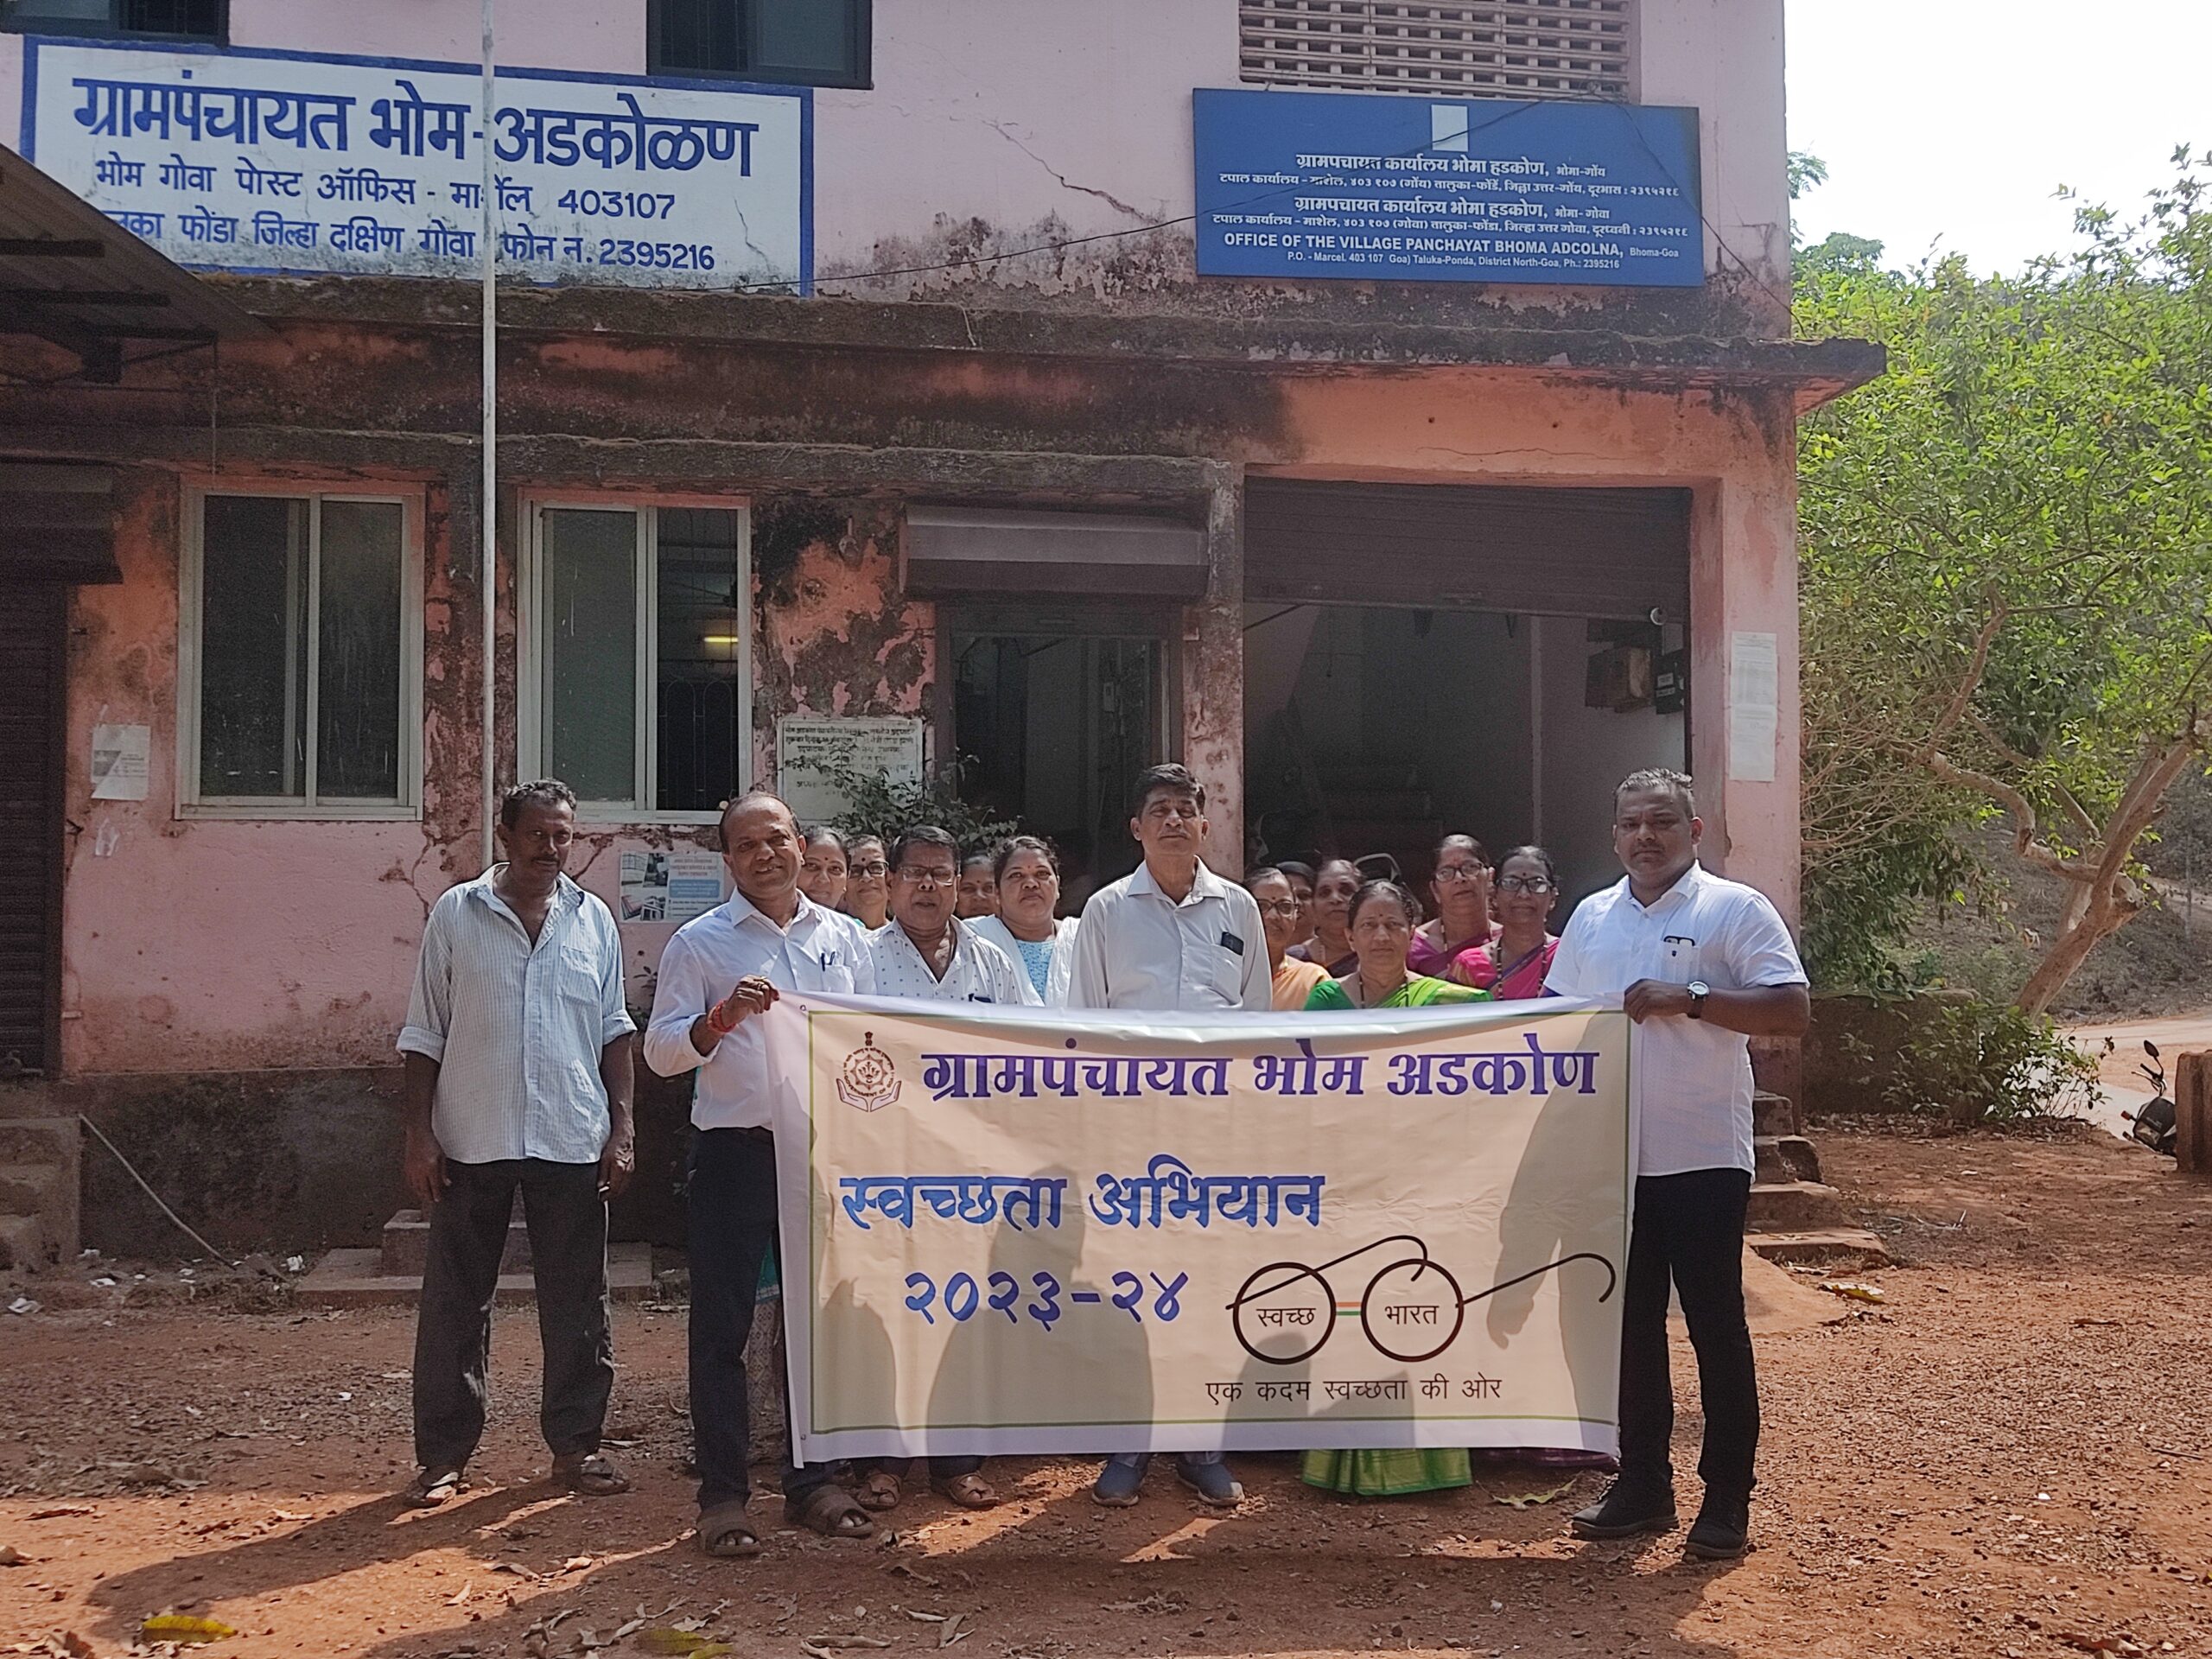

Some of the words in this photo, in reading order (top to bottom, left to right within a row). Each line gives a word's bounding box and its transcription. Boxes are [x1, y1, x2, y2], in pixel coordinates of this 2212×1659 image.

[73, 70, 356, 151] ग्रामपंचायत
[1219, 173, 1250, 183] टपाल
[1252, 172, 1300, 185] कार्यालय
[1351, 177, 1372, 187] ४०३
[1375, 178, 1397, 188] १०७
[1384, 153, 1449, 172] कार्यालय
[1452, 155, 1487, 174] भोमा
[1490, 156, 1549, 177] हडकोण,
[95, 151, 145, 188] भोम
[159, 153, 217, 192] गोवा
[235, 156, 303, 197] पोस्ट
[317, 167, 416, 204] ऑफिस
[558, 189, 676, 219] 403107
[1382, 195, 1447, 214] कार्यालय
[1451, 197, 1485, 215] भोमा
[1488, 199, 1548, 219] हडकोण,
[178, 205, 238, 244] फोंडा
[252, 210, 320, 249] जिल्हा
[330, 216, 404, 253] दक्षिण
[417, 219, 476, 257] गोवा
[499, 223, 557, 261] फोन
[1212, 214, 1243, 224] टपाल
[1245, 213, 1293, 226] कार्यालय
[1344, 219, 1365, 227] ४०३
[1368, 219, 1389, 228] १०७
[1537, 223, 1559, 233] उत्तर
[1224, 232, 1278, 247] OFFICE
[1281, 234, 1302, 248] OF
[1305, 235, 1336, 249] THE
[1339, 236, 1402, 251] VILLAGE
[1406, 238, 1491, 253] PANCHAYAT
[1495, 239, 1548, 254] BHOMA
[1551, 241, 1624, 258] ADCOLNA,
[1630, 247, 1679, 257] Bhoma-Goa
[1287, 251, 1306, 261] P.O.
[1349, 253, 1365, 263] 403
[1368, 253, 1383, 263] 107
[1389, 254, 1411, 265] Goa)
[1413, 254, 1477, 267] Taluka-Ponda,
[1478, 256, 1511, 267] District
[1583, 259, 1620, 269] 2395216
[921, 1038, 1233, 1102] ग्रामपंचायत
[1252, 1038, 1370, 1096] भोम
[1387, 1033, 1600, 1096] अडकोण
[839, 1175, 1068, 1232] स्वच्छता
[1089, 1154, 1326, 1230] अभियान
[905, 1270, 1190, 1333] २०२३-२४
[1256, 1306, 1317, 1327] स्वच्छ
[1384, 1304, 1440, 1325] भारत
[1205, 1382, 1243, 1406] एक
[1255, 1381, 1312, 1402] कदम
[1323, 1380, 1408, 1401] स्वच्छता
[1420, 1372, 1450, 1400] की
[1462, 1371, 1503, 1400] ओर
